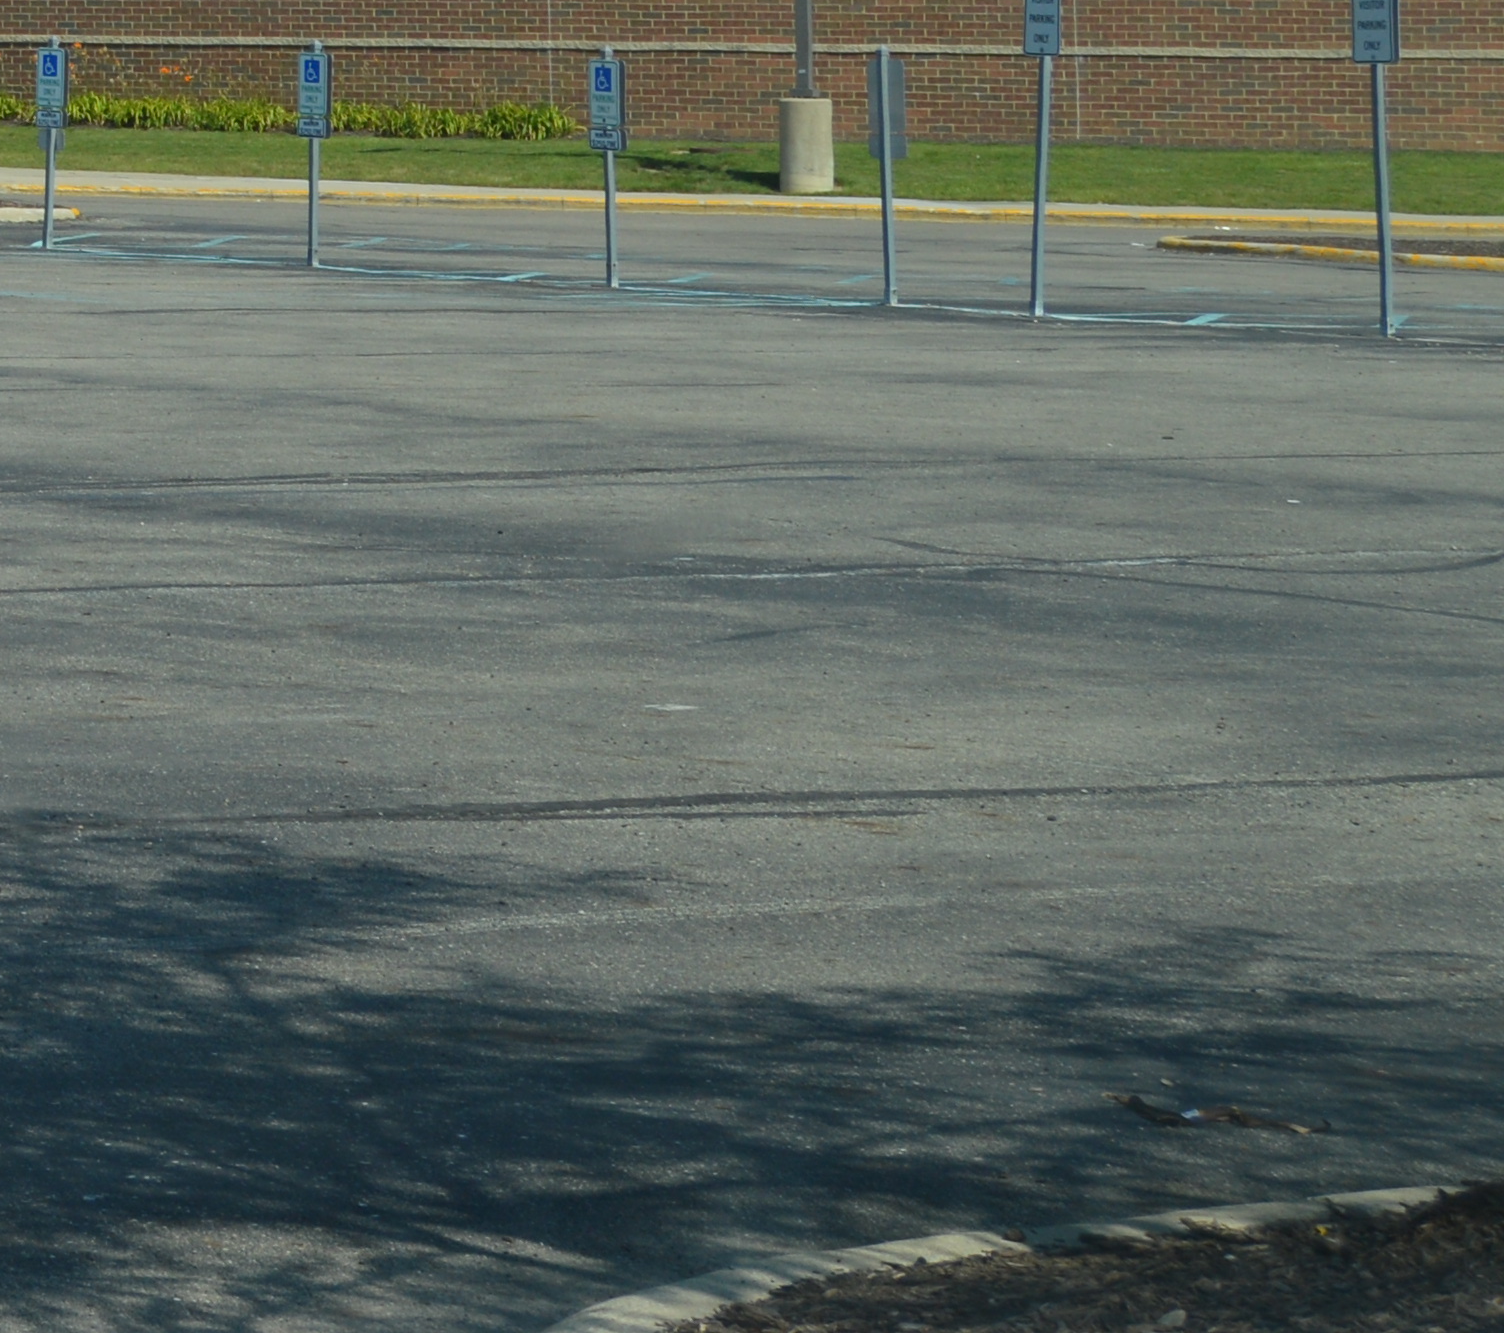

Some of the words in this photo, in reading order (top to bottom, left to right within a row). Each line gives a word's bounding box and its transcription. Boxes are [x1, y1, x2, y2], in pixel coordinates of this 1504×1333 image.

[1359, 0, 1385, 10] VISITOR
[1029, 14, 1055, 24] PARKING
[1357, 20, 1387, 30] PARKING
[1033, 33, 1049, 44] ONLY
[1363, 40, 1381, 51] ONLY
